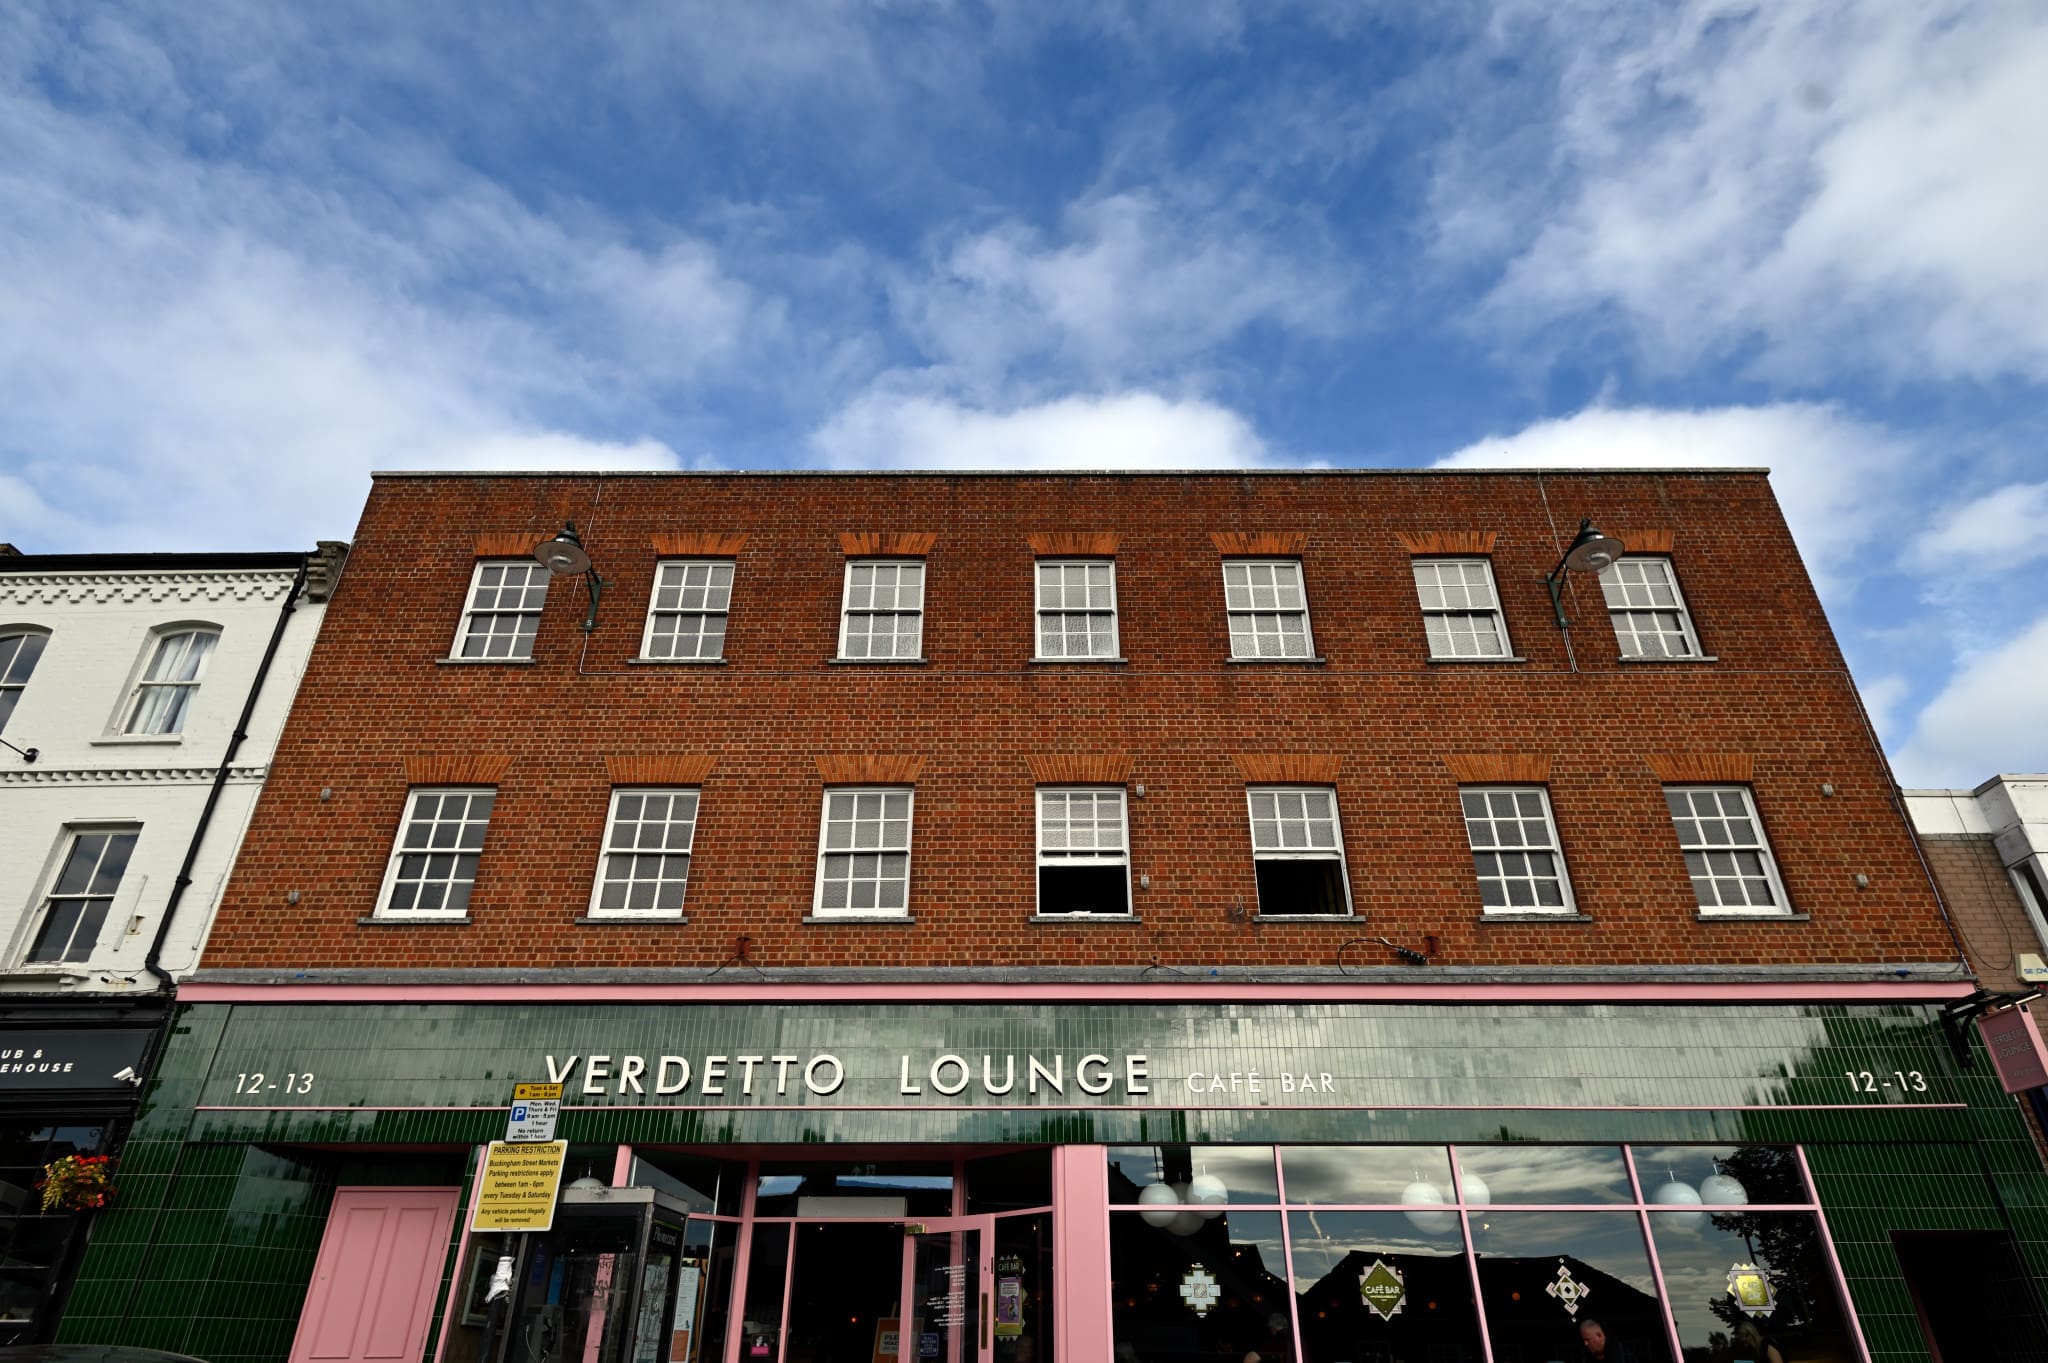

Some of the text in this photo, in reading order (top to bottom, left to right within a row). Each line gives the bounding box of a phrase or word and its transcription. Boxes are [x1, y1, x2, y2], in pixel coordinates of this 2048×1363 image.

[33, 1049, 43, 1059] &
[545, 1054, 1150, 1097] VERDETTO LOUNGE
[1187, 1067, 1336, 1094] CAFÉ BAR
[493, 1145, 561, 1154] PARKING RESTRICTION
[489, 1160, 521, 1168] Buckingham
[489, 1170, 509, 1178] Parking
[540, 1169, 554, 1177] apply
[500, 1192, 521, 1200] Tuesday
[528, 1191, 551, 1200] Saturday
[1385, 1286, 1400, 1294] BAR
